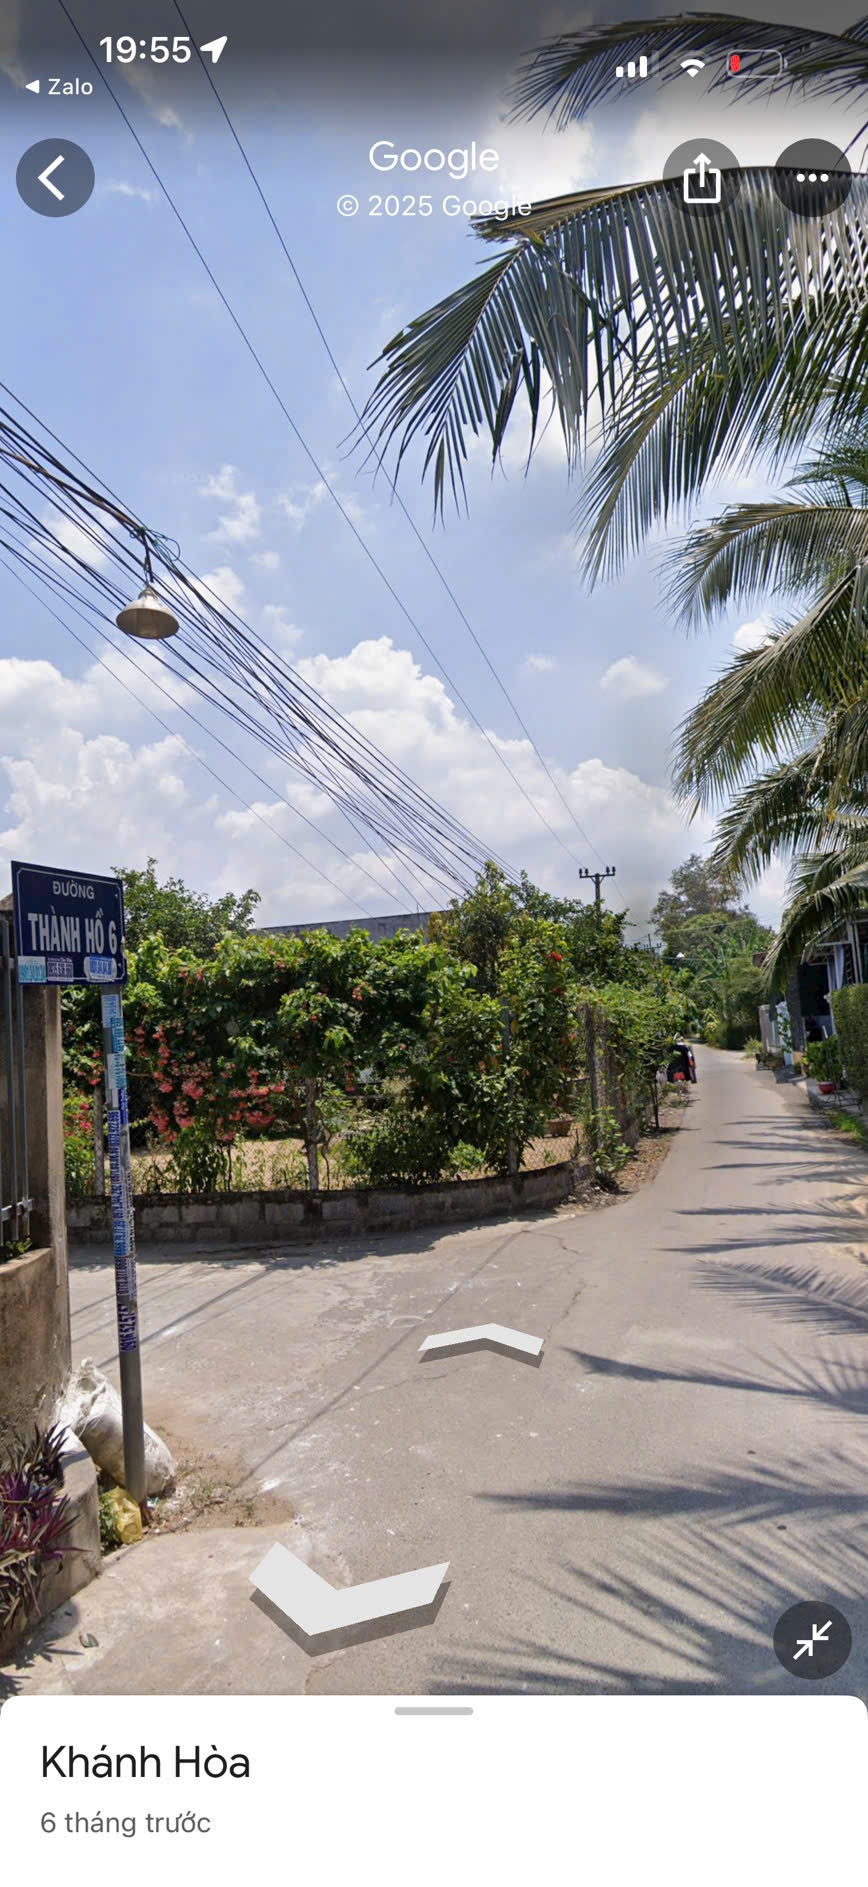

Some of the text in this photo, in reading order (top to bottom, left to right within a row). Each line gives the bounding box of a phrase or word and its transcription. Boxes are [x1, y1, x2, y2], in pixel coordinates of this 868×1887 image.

[52, 880, 95, 899] ĐƯỜNG
[27, 904, 118, 955] THÀNH HỒ 6
